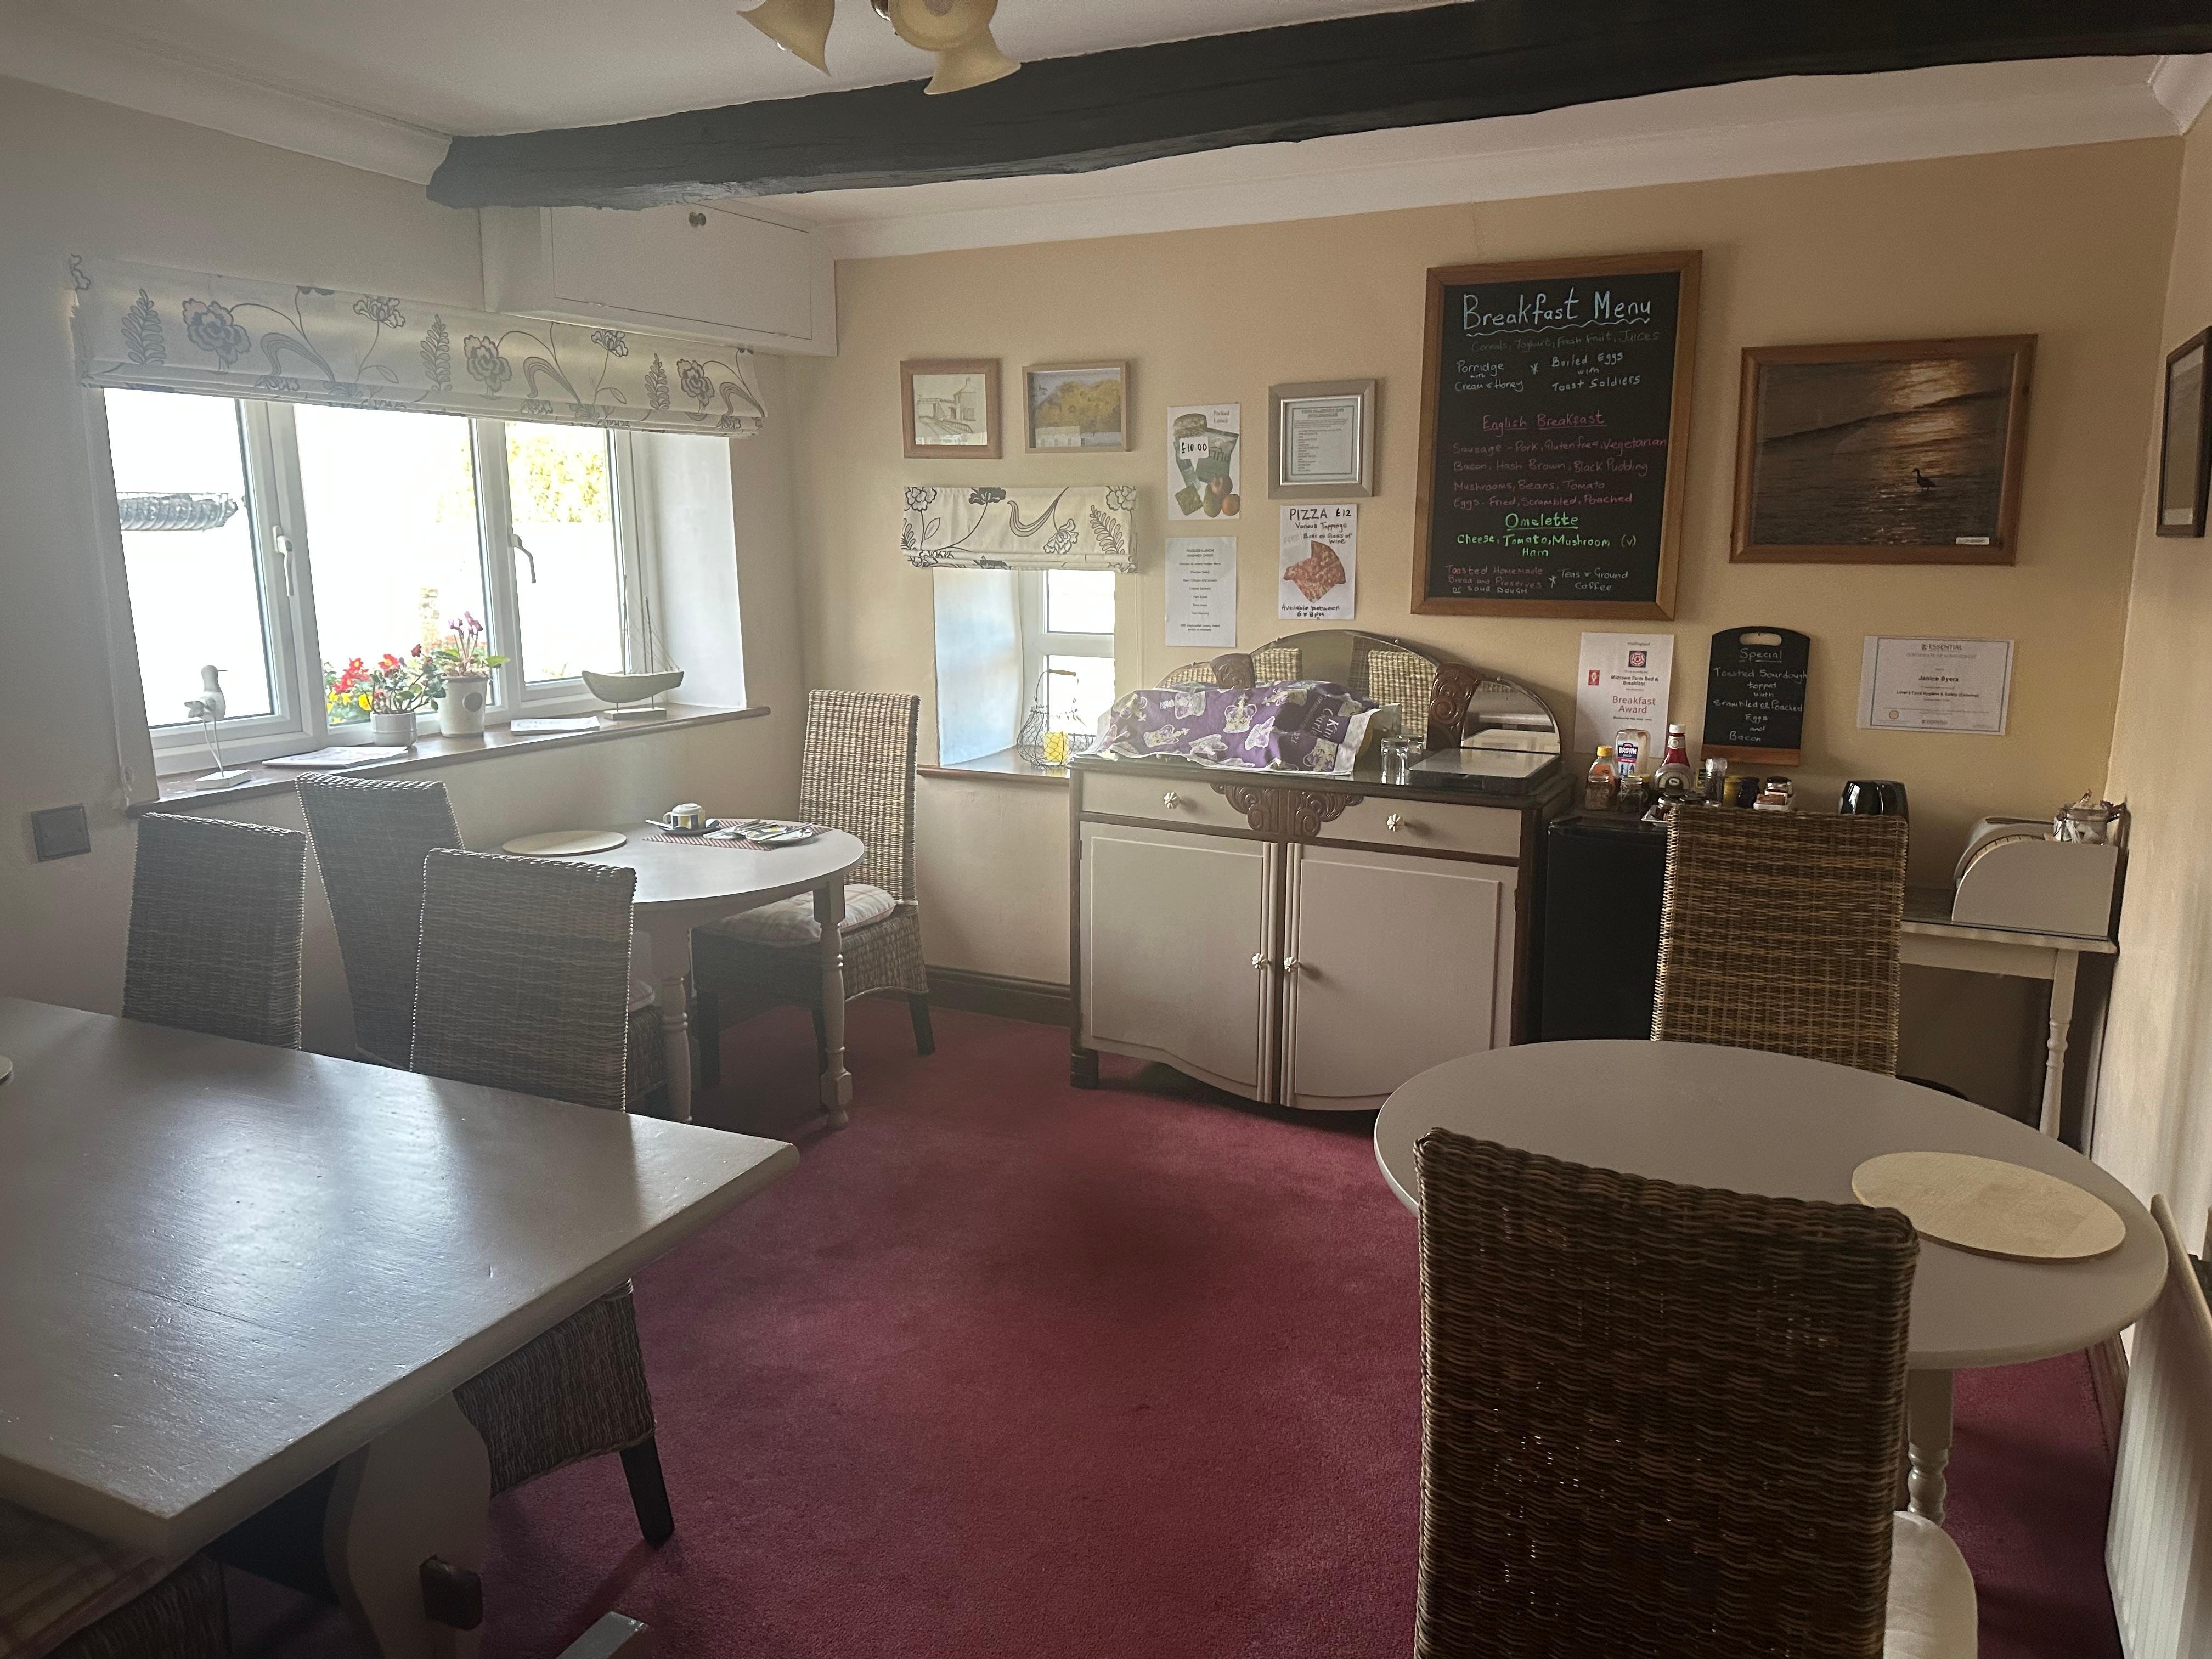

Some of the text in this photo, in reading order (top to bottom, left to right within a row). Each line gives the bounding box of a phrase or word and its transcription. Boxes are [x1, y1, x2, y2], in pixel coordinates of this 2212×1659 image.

[1463, 287, 1651, 329] Breakfast Menu
[1558, 336, 1581, 347] Fresh
[1619, 330, 1660, 343] Juices
[1551, 352, 1623, 367] Boiled Eggs
[1457, 360, 1504, 377] Porridge
[1454, 381, 1483, 392] Cream
[1493, 379, 1523, 392] Honey
[1551, 375, 1641, 391] Toast Soldiers
[1483, 409, 1606, 437] English Breakfast
[1453, 443, 1502, 456] Sausage
[1496, 459, 1522, 471] Hash
[1573, 460, 1603, 473] Black
[1606, 457, 1648, 477] Pudding
[1562, 478, 1605, 490] Tomato
[1584, 493, 1633, 505] Poached
[1290, 508, 1328, 521] PIZZA
[1505, 511, 1579, 528] Omelette
[1320, 521, 1348, 533] Toppings
[1522, 548, 1549, 557] Ham
[1444, 565, 1488, 575] Toasted
[1557, 568, 1581, 578] Teas
[1594, 567, 1629, 579] Ground
[1448, 575, 1473, 584] Bread
[1496, 576, 1542, 589] Preserves
[1575, 581, 1612, 591] Coffee
[1740, 647, 1782, 662] Special
[1713, 667, 1808, 684] Toasted Sourdough
[1747, 681, 1776, 691] topped
[1612, 696, 1656, 706] Breakfast
[1771, 699, 1803, 712] Poached
[1618, 705, 1647, 714] Award
[1745, 713, 1769, 724] Eggs
[1729, 730, 1762, 741] Bacon
[1619, 747, 1637, 755] BROWN
